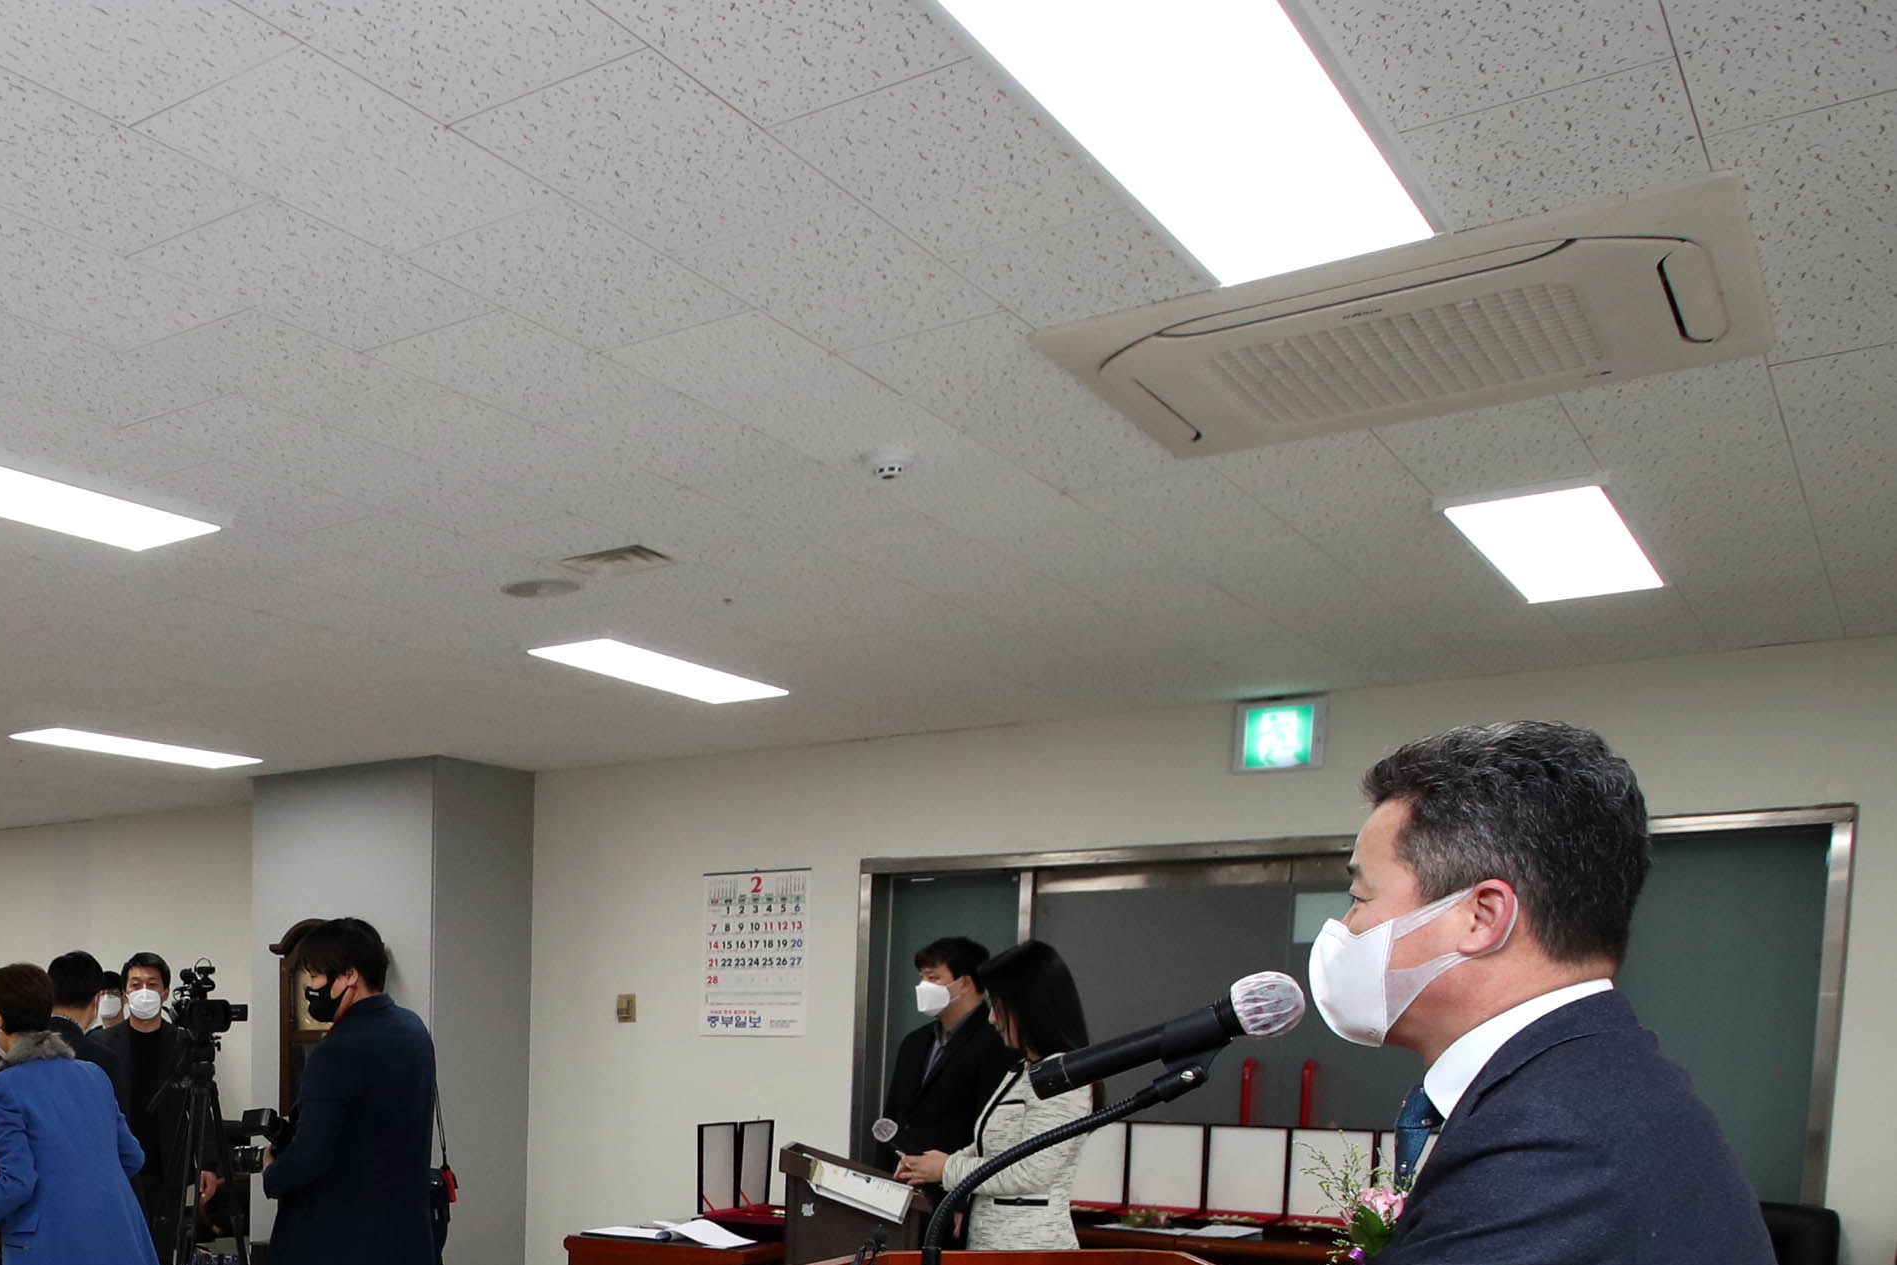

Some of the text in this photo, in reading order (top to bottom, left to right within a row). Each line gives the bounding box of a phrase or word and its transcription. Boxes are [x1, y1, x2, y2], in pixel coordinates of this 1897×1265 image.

[750, 876, 763, 893] 2
[738, 906, 745, 914] 2
[752, 905, 759, 913] 3
[780, 904, 786, 912] 5
[794, 904, 800, 912] 6
[711, 921, 802, 933] 7 8 9 10 11 12 13
[722, 941, 732, 949] 15
[736, 940, 746, 949] 16
[750, 940, 760, 948] 17
[763, 939, 773, 948] 18
[777, 939, 787, 947] 19
[791, 939, 802, 948] 20
[708, 957, 802, 967] 21 22 23 24 25 26 27
[707, 976, 718, 984] 28
